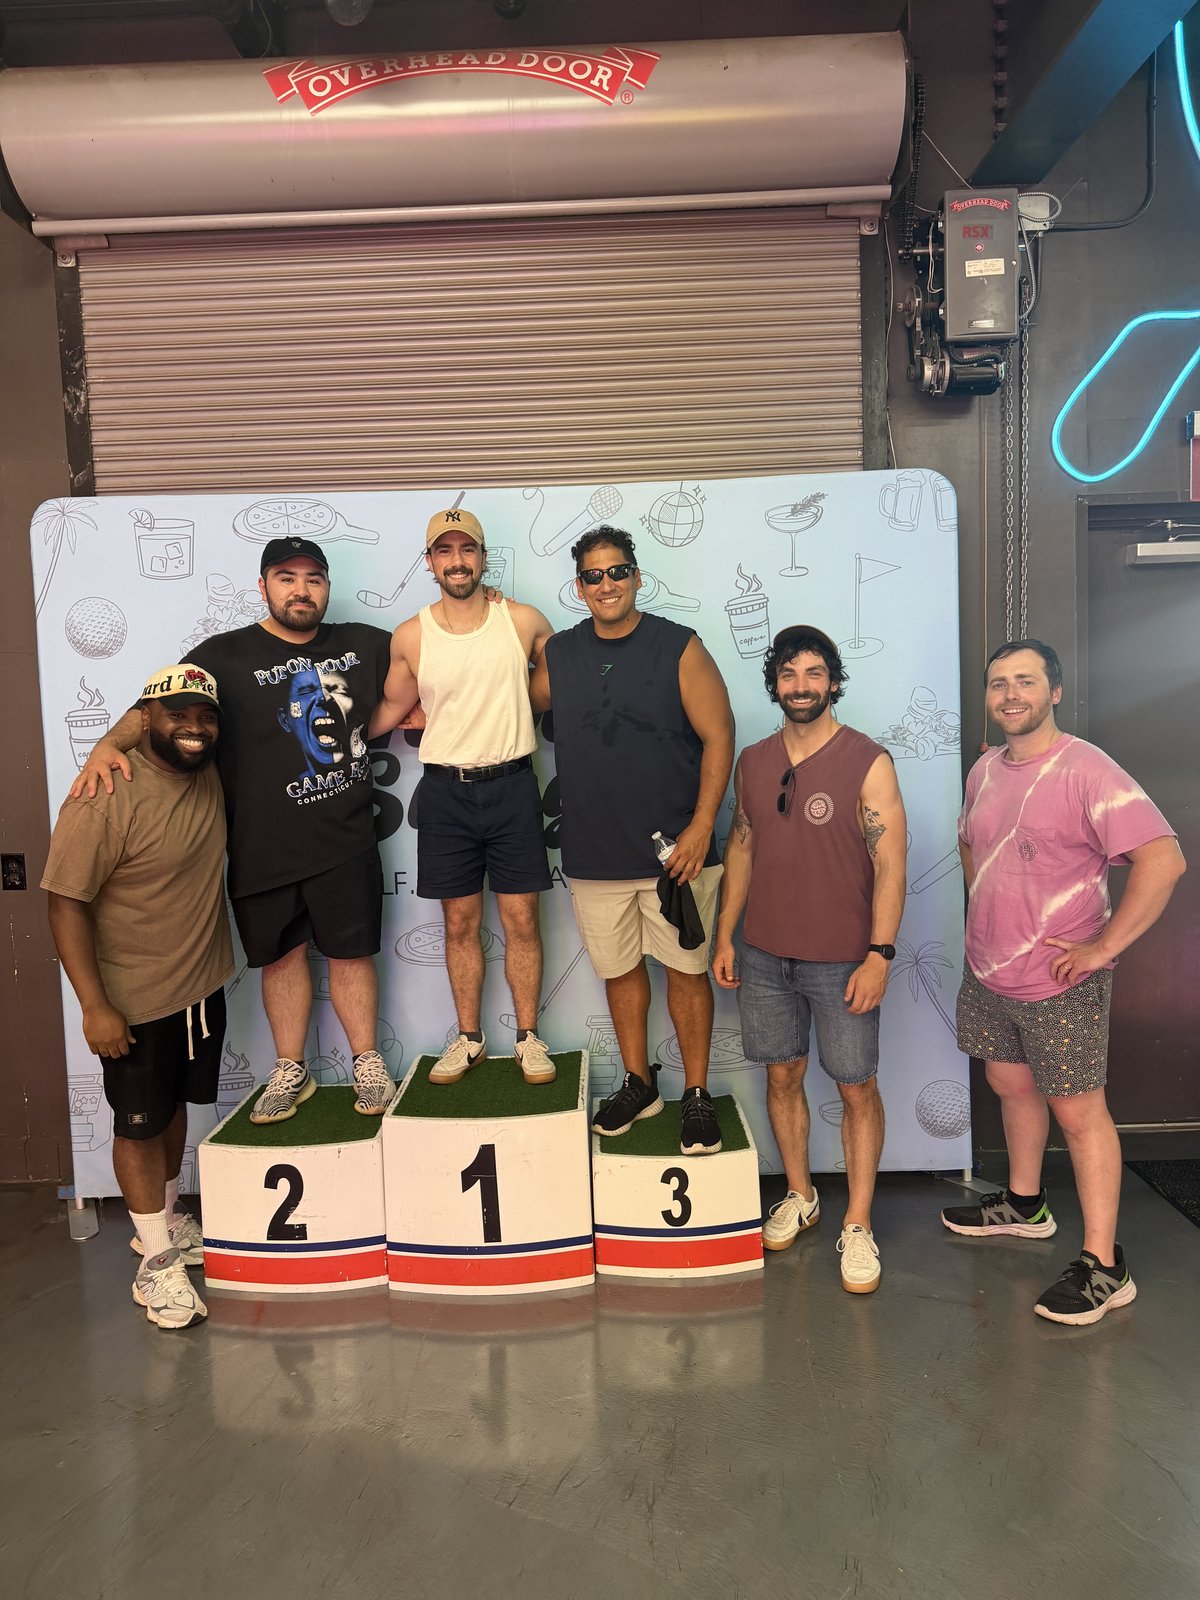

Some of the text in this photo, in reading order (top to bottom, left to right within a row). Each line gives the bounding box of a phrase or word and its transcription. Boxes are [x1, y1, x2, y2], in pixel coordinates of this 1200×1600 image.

[308, 52, 506, 97] OVERHEAD
[517, 52, 615, 92] DOOR
[956, 199, 989, 210] OVERHEAD
[962, 225, 989, 239] RSX
[253, 652, 361, 686] PUT ON YOUR
[286, 769, 346, 798] GAME
[296, 779, 354, 806] CONNECTICUT
[263, 1163, 309, 1242] 2
[460, 1143, 503, 1244] 1
[659, 1166, 693, 1228] 3
